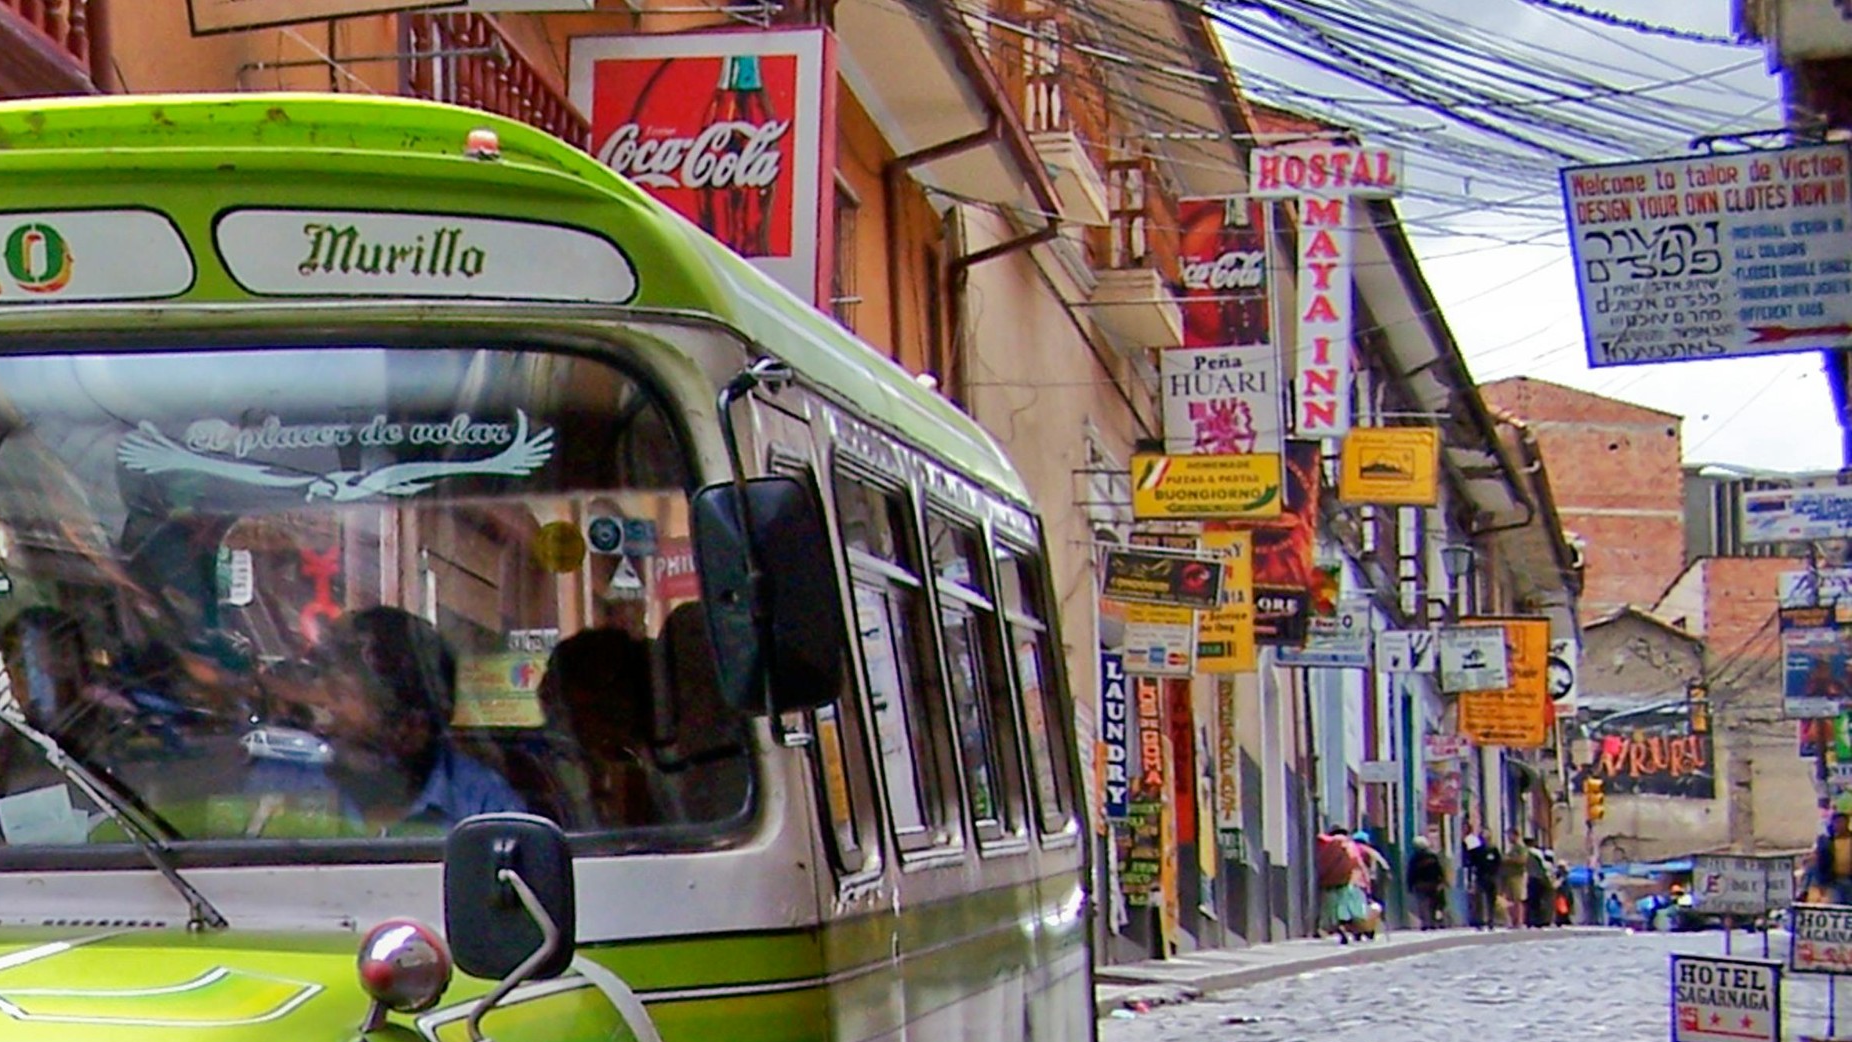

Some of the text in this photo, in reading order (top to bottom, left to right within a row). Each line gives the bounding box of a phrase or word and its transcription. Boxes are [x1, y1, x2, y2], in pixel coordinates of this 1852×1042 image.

[1258, 152, 1396, 189] HOSTAL
[1571, 173, 1646, 197] Welcome
[1655, 168, 1676, 190] to
[1749, 160, 1770, 181] de
[1577, 199, 1632, 225] DESIGN
[1637, 194, 1679, 219] YOUR
[1685, 189, 1719, 215] OWN
[1725, 185, 1786, 212] CLOTES
[1792, 183, 1826, 207] NOW
[298, 223, 486, 278] Murillo
[1303, 199, 1342, 323] MAYA
[1193, 354, 1242, 371] Peña
[1171, 373, 1267, 397] HUARI
[1302, 337, 1341, 429] INN
[234, 415, 354, 458] placer
[357, 414, 404, 446] de
[409, 413, 512, 444] volar
[1155, 488, 1261, 501] BUONGIORNO
[1105, 661, 1128, 804] LAUNDRY
[1680, 963, 1766, 991] HOTEL
[1676, 985, 1770, 1012] SAGARNAGA
